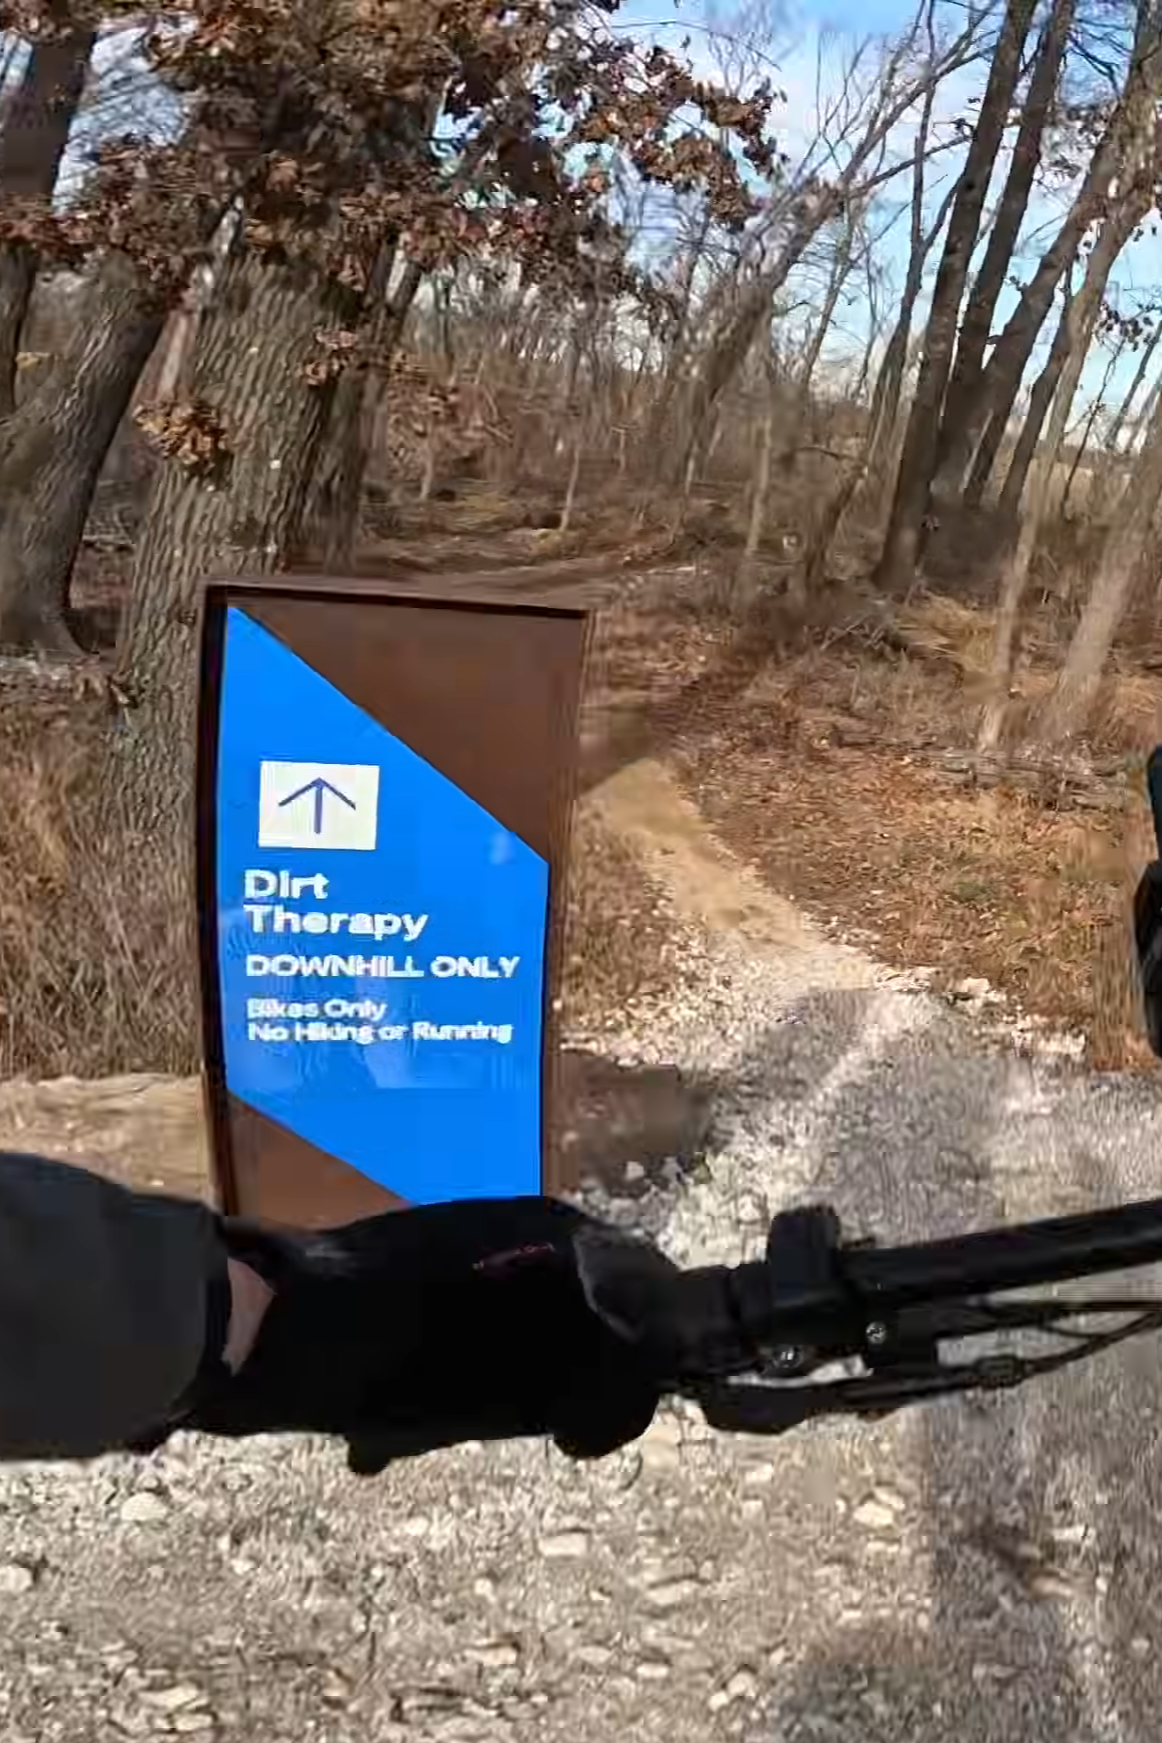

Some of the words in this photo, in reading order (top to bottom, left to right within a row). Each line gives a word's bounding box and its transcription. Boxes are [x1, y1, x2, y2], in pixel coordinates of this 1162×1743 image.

[244, 868, 330, 900] Dirt
[244, 903, 429, 942] Therapy
[246, 954, 425, 978] DOWNHILL
[430, 955, 520, 979] ONLY
[247, 998, 319, 1019] Bikes
[324, 998, 388, 1021] Only
[248, 1022, 289, 1041] No
[295, 1022, 374, 1045] Hiking
[377, 1025, 408, 1041] or
[412, 1021, 514, 1044] Running
